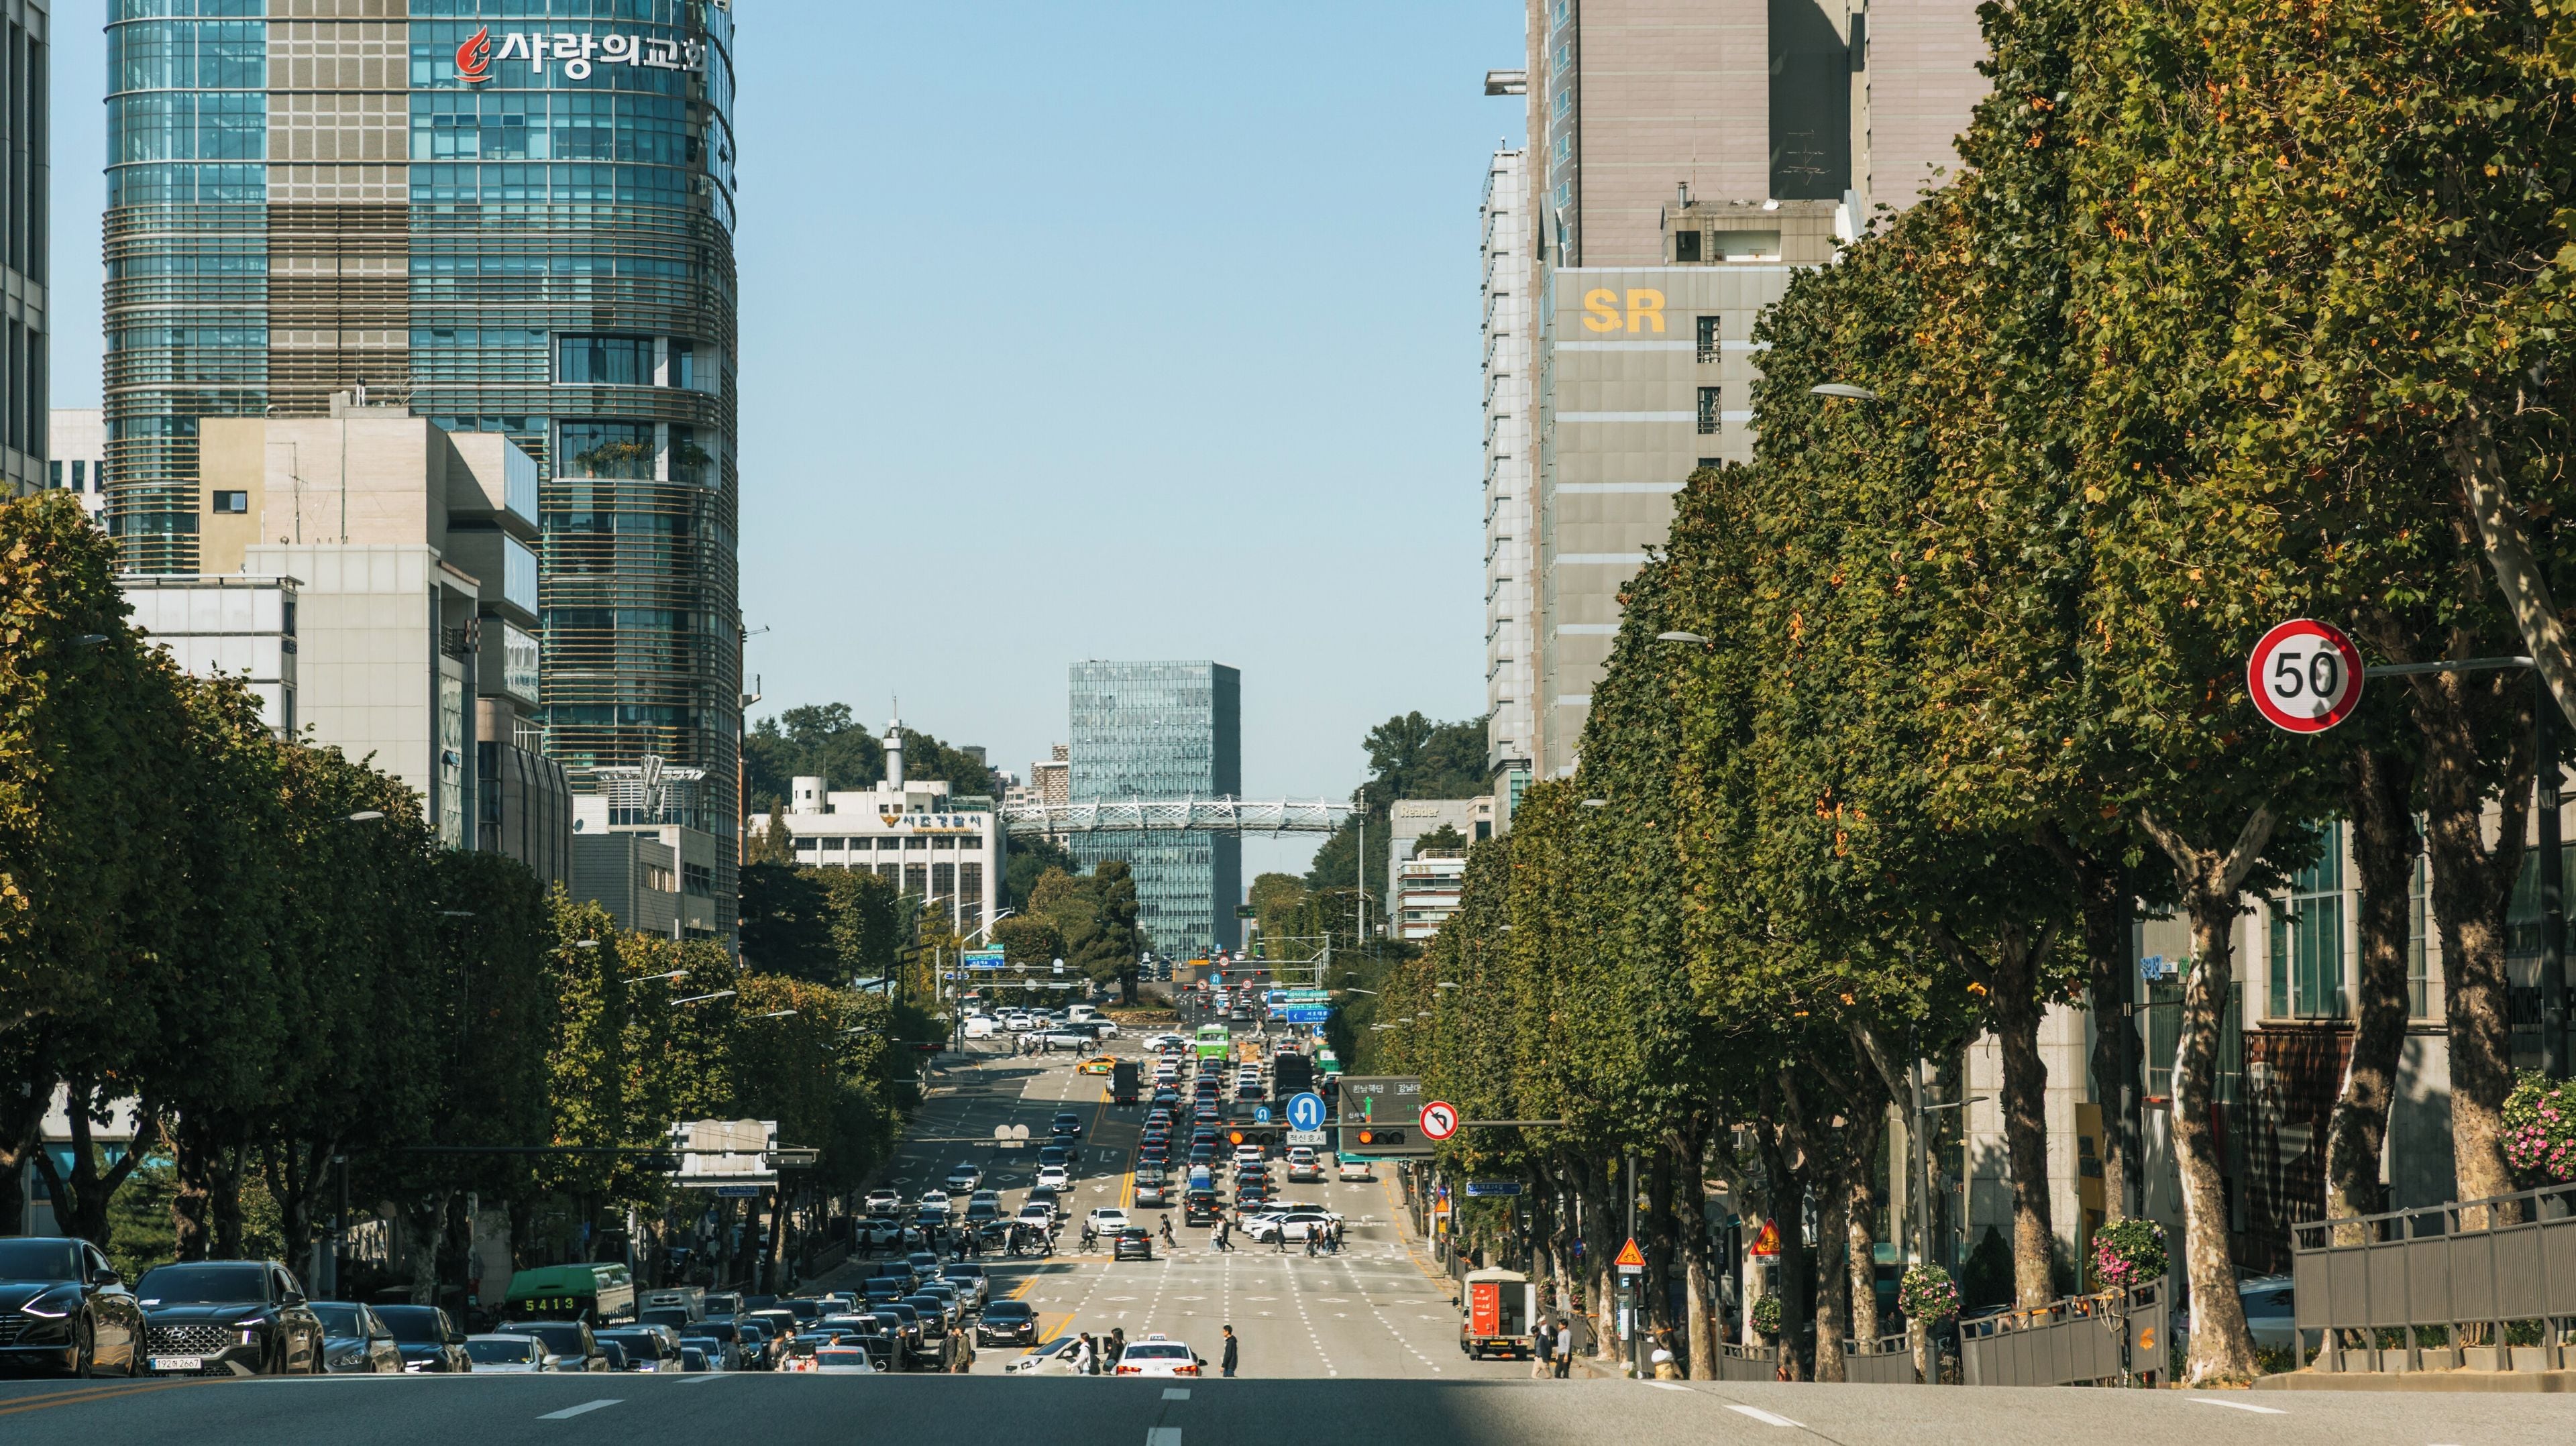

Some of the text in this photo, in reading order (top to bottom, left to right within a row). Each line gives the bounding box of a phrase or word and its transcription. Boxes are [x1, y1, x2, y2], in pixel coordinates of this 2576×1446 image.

[496, 32, 708, 80] 사랑의교회
[2274, 652, 2338, 698] 50
[1401, 805, 1439, 818] Reader
[1399, 1083, 1421, 1093] 강남대
[1289, 1134, 1324, 1143] 적신호시
[526, 1297, 574, 1311] 5413
